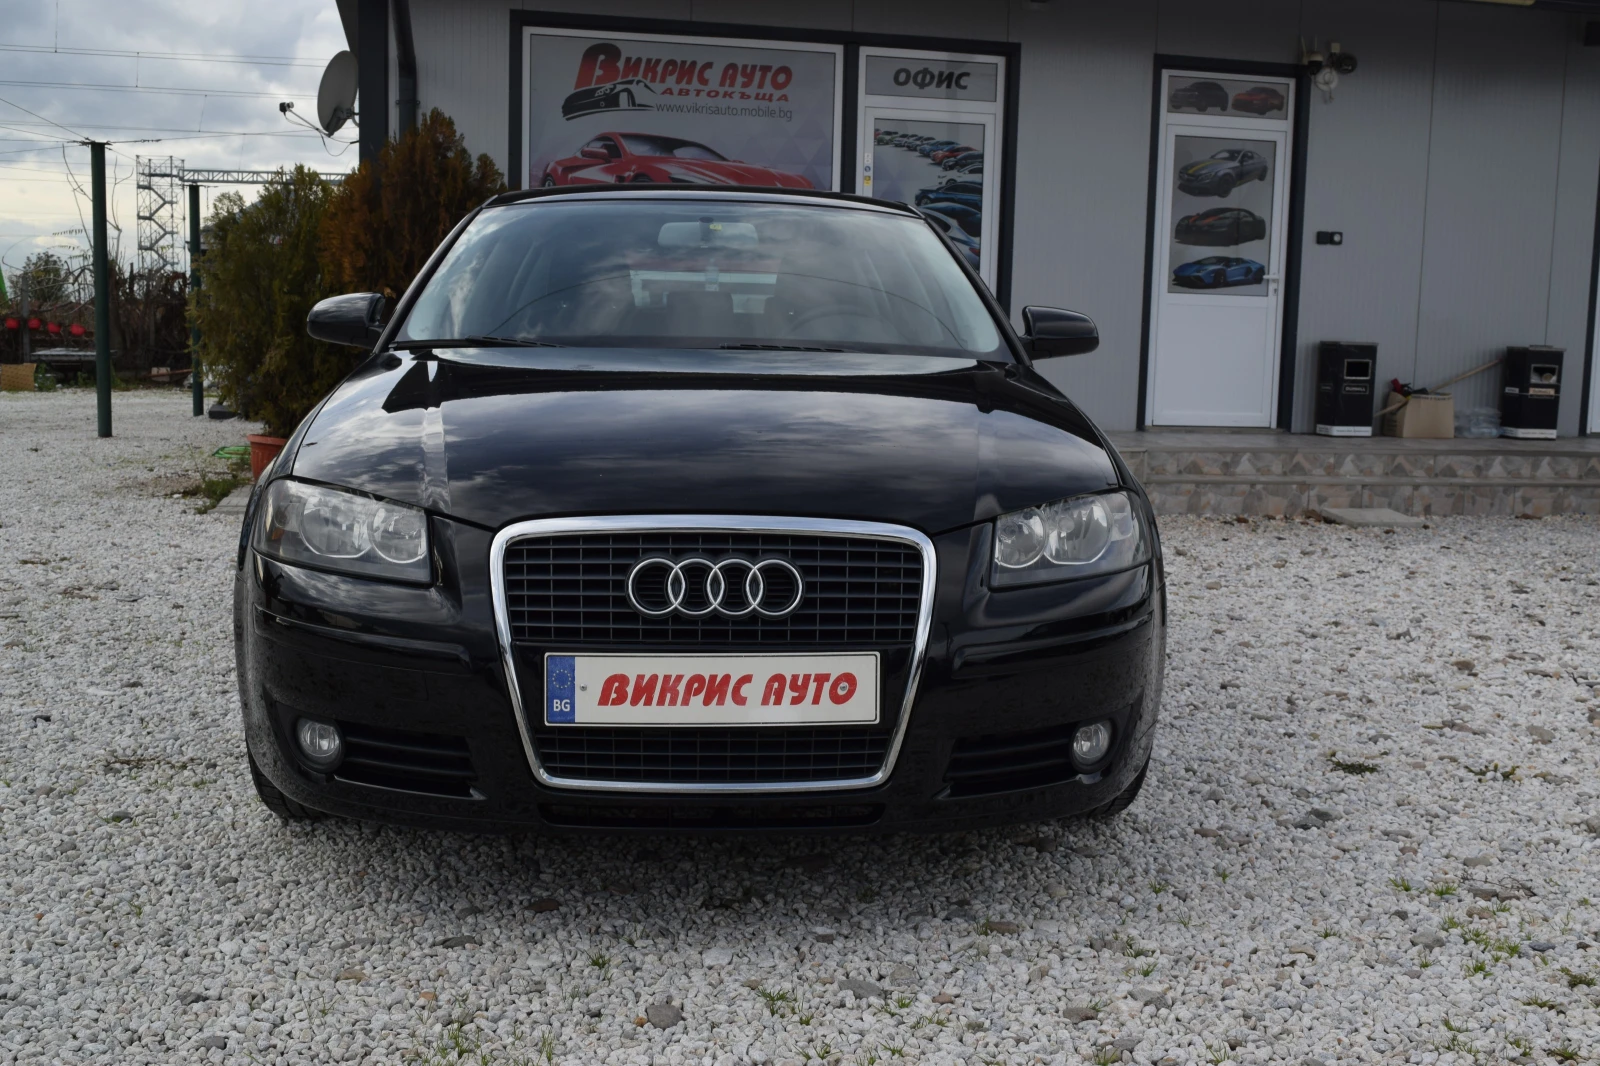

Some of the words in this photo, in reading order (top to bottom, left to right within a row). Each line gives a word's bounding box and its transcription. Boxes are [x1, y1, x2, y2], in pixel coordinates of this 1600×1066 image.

[574, 43, 714, 90] ВИКРИС
[719, 63, 793, 91] АУТО
[893, 67, 971, 90] ОФИС
[660, 87, 790, 102] АВТОКЪЩА
[655, 102, 793, 122] www.vikrisauto.mobile.bg
[597, 673, 754, 707] ВИКРИС
[760, 672, 858, 706] АУТО
[553, 699, 571, 712] BG
